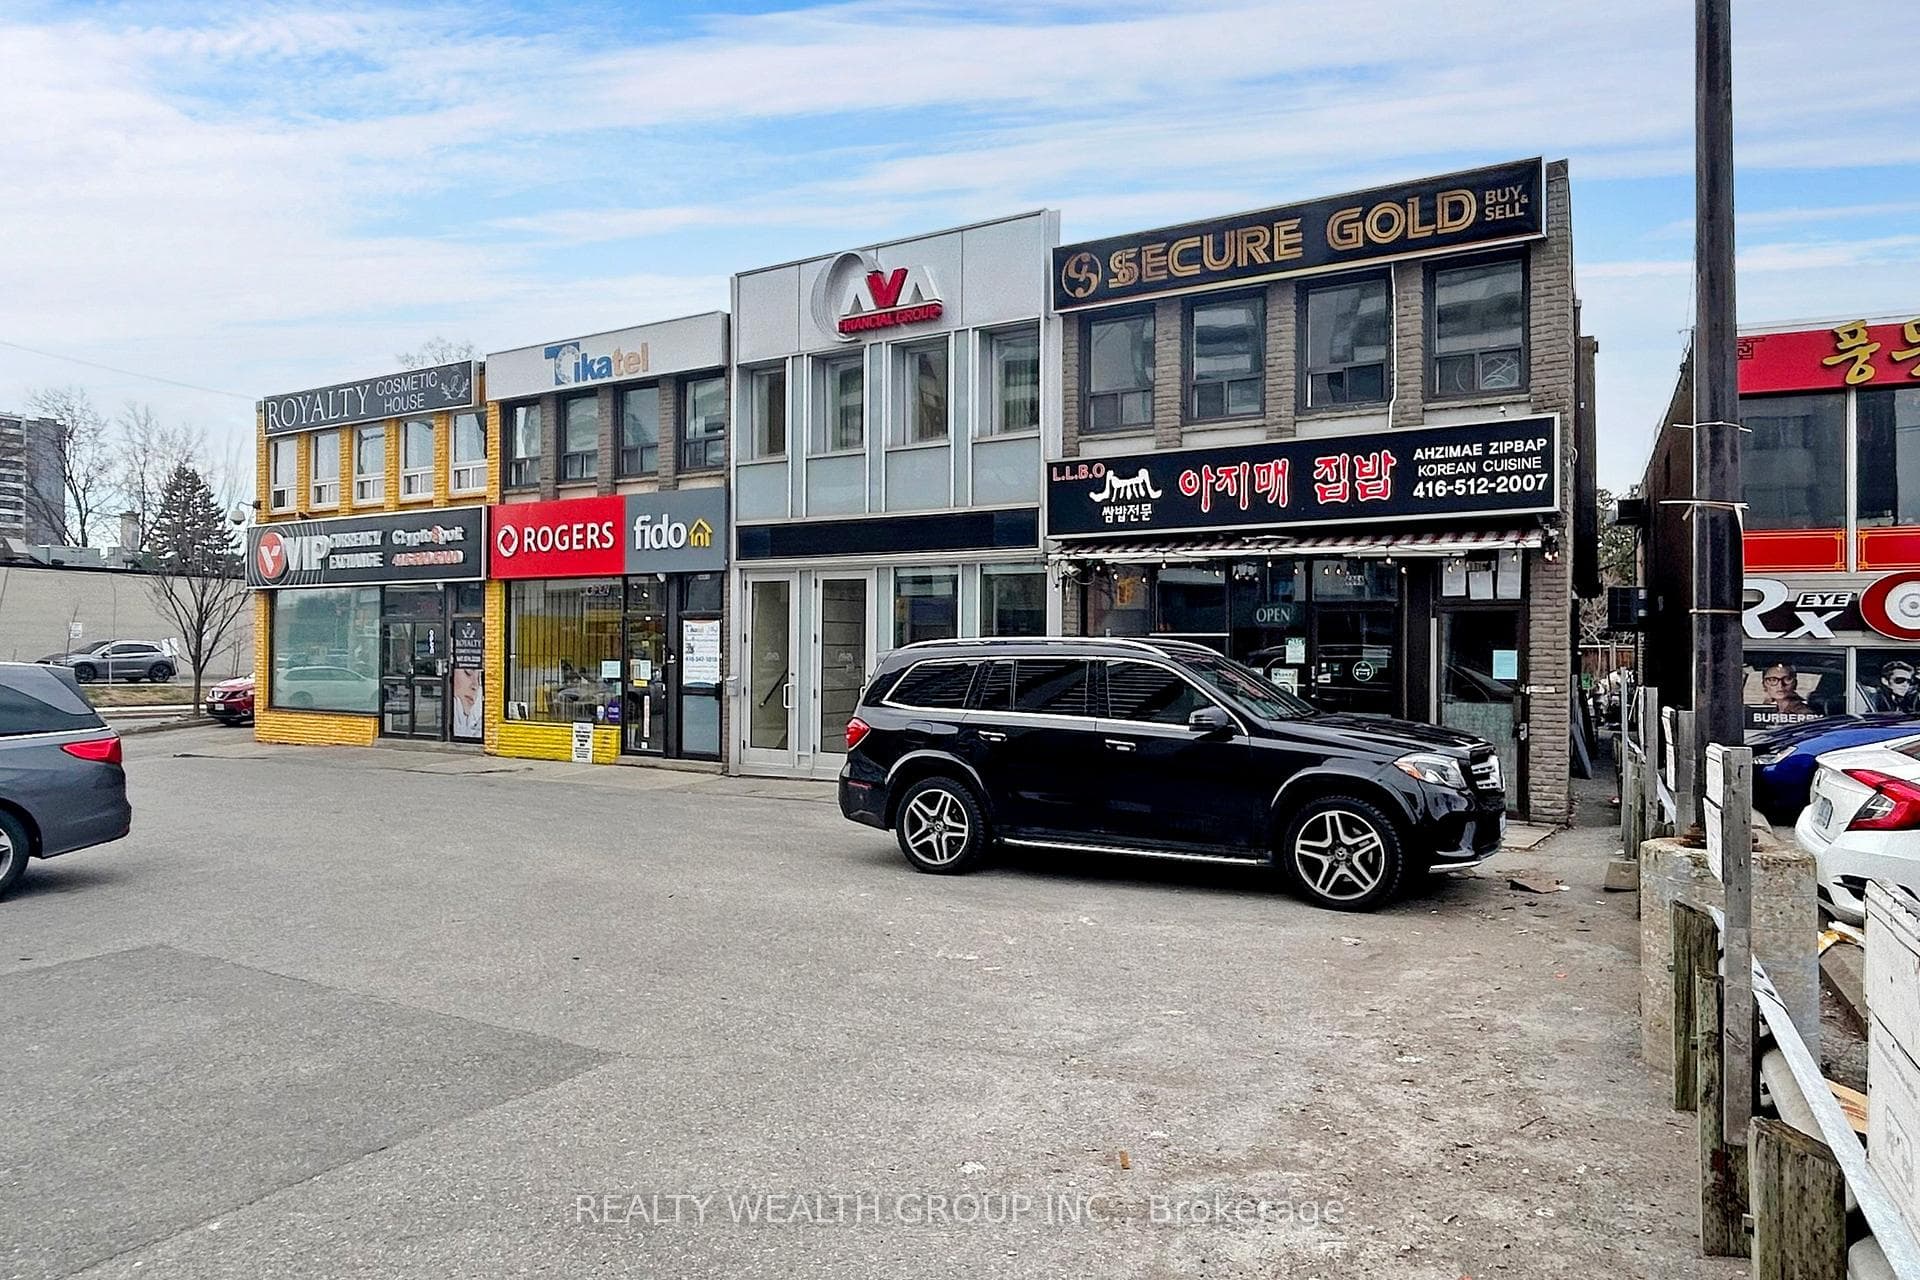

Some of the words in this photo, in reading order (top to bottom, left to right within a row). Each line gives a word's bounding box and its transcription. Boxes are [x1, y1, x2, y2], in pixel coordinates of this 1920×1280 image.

[1485, 184, 1522, 204] BUY
[1485, 202, 1525, 221] SELL
[1108, 217, 1302, 288] SECURE
[1327, 189, 1477, 251] GOLD
[839, 312, 895, 332] FINANCIAL
[896, 304, 941, 323] GROUP
[544, 341, 649, 386] Tikatel
[376, 371, 438, 397] COSMETIC
[267, 384, 370, 430] ROYALTY
[384, 393, 425, 415] HOUSE
[1413, 443, 1483, 461] AHZIMAE
[1489, 438, 1547, 456] ZIPBAP
[1052, 463, 1105, 481] L.L.B.O
[1418, 461, 1476, 477] KOREAN
[1483, 456, 1541, 472] CUISINE
[1179, 457, 1290, 513] 아지매
[1313, 450, 1397, 505] 집밥
[1413, 473, 1548, 498] 416-512-2007
[1102, 503, 1153, 523] 쌈밥전문
[523, 521, 615, 553] ROGERS
[633, 513, 688, 550] fido
[284, 534, 330, 571] VIP
[1799, 593, 1848, 606] EYE
[1256, 607, 1290, 622] OPEN
